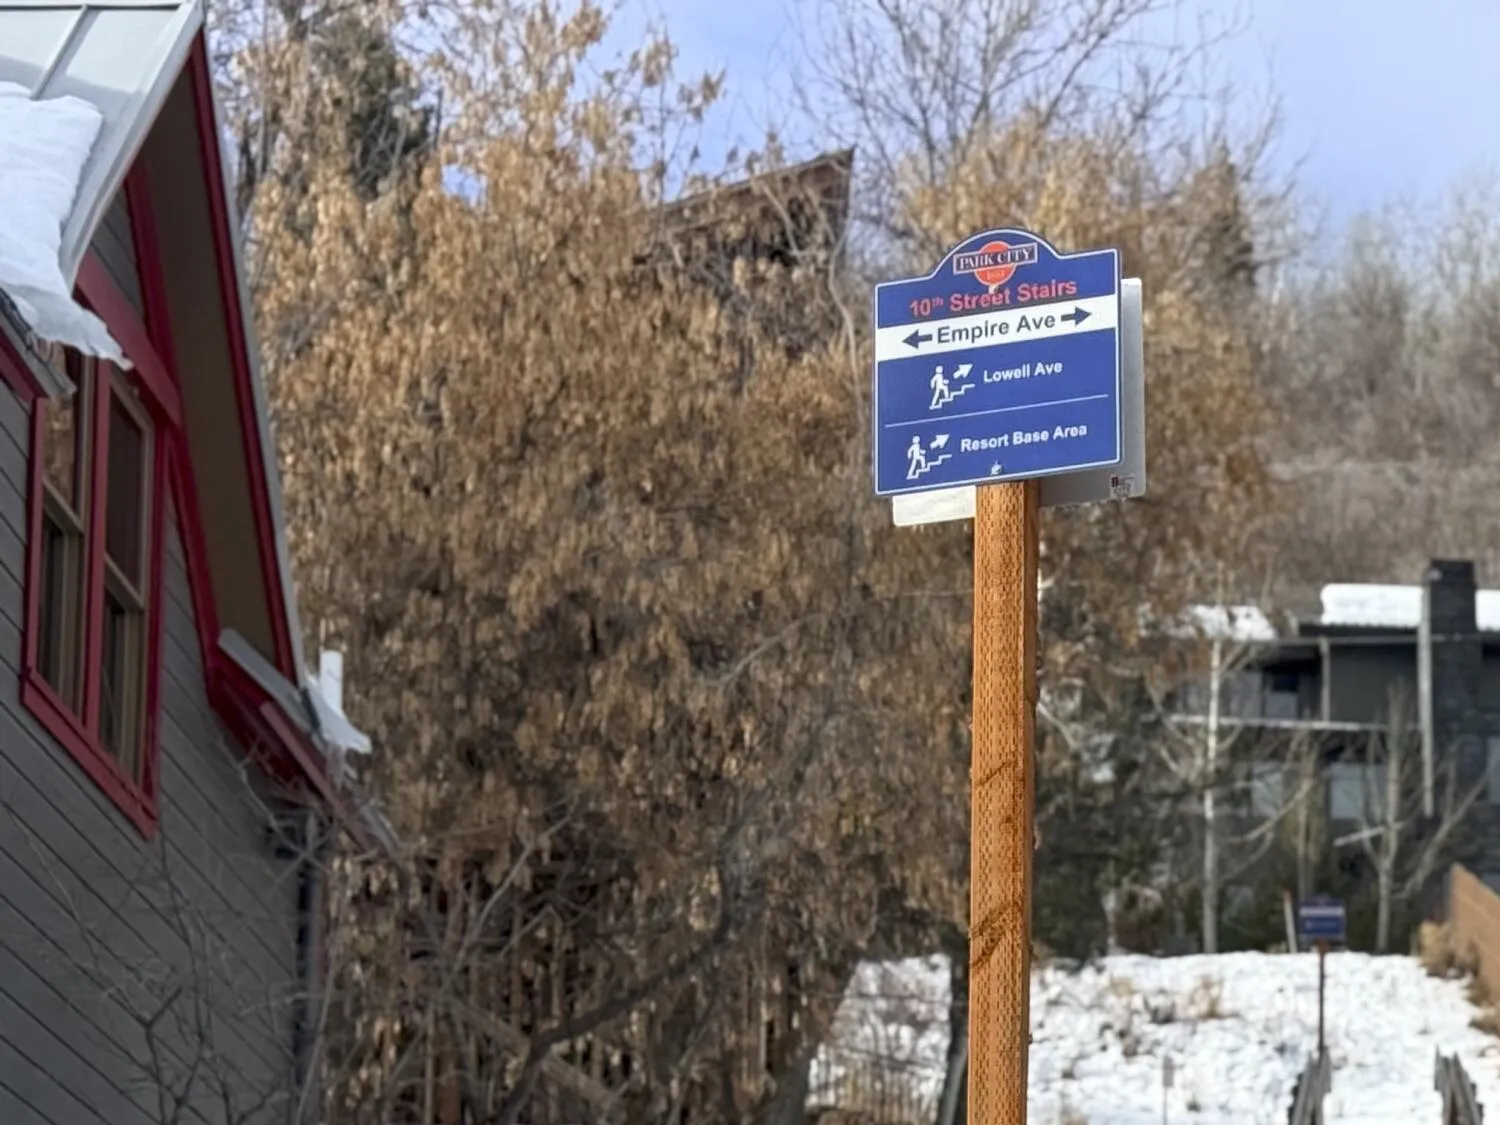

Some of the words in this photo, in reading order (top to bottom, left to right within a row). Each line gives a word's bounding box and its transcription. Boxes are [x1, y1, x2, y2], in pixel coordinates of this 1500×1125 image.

[959, 254, 994, 270] PARK
[997, 247, 1032, 263] CITY
[909, 295, 944, 318] 10th
[950, 289, 1011, 312] Street
[1018, 280, 1078, 302] Stairs
[937, 318, 1010, 344] Empire
[1016, 315, 1056, 333] Ave
[983, 364, 1031, 383] Lowell
[1034, 360, 1063, 376] Ave
[960, 435, 1009, 453] Resort
[1013, 430, 1049, 446] Base
[1053, 424, 1088, 441] Area
